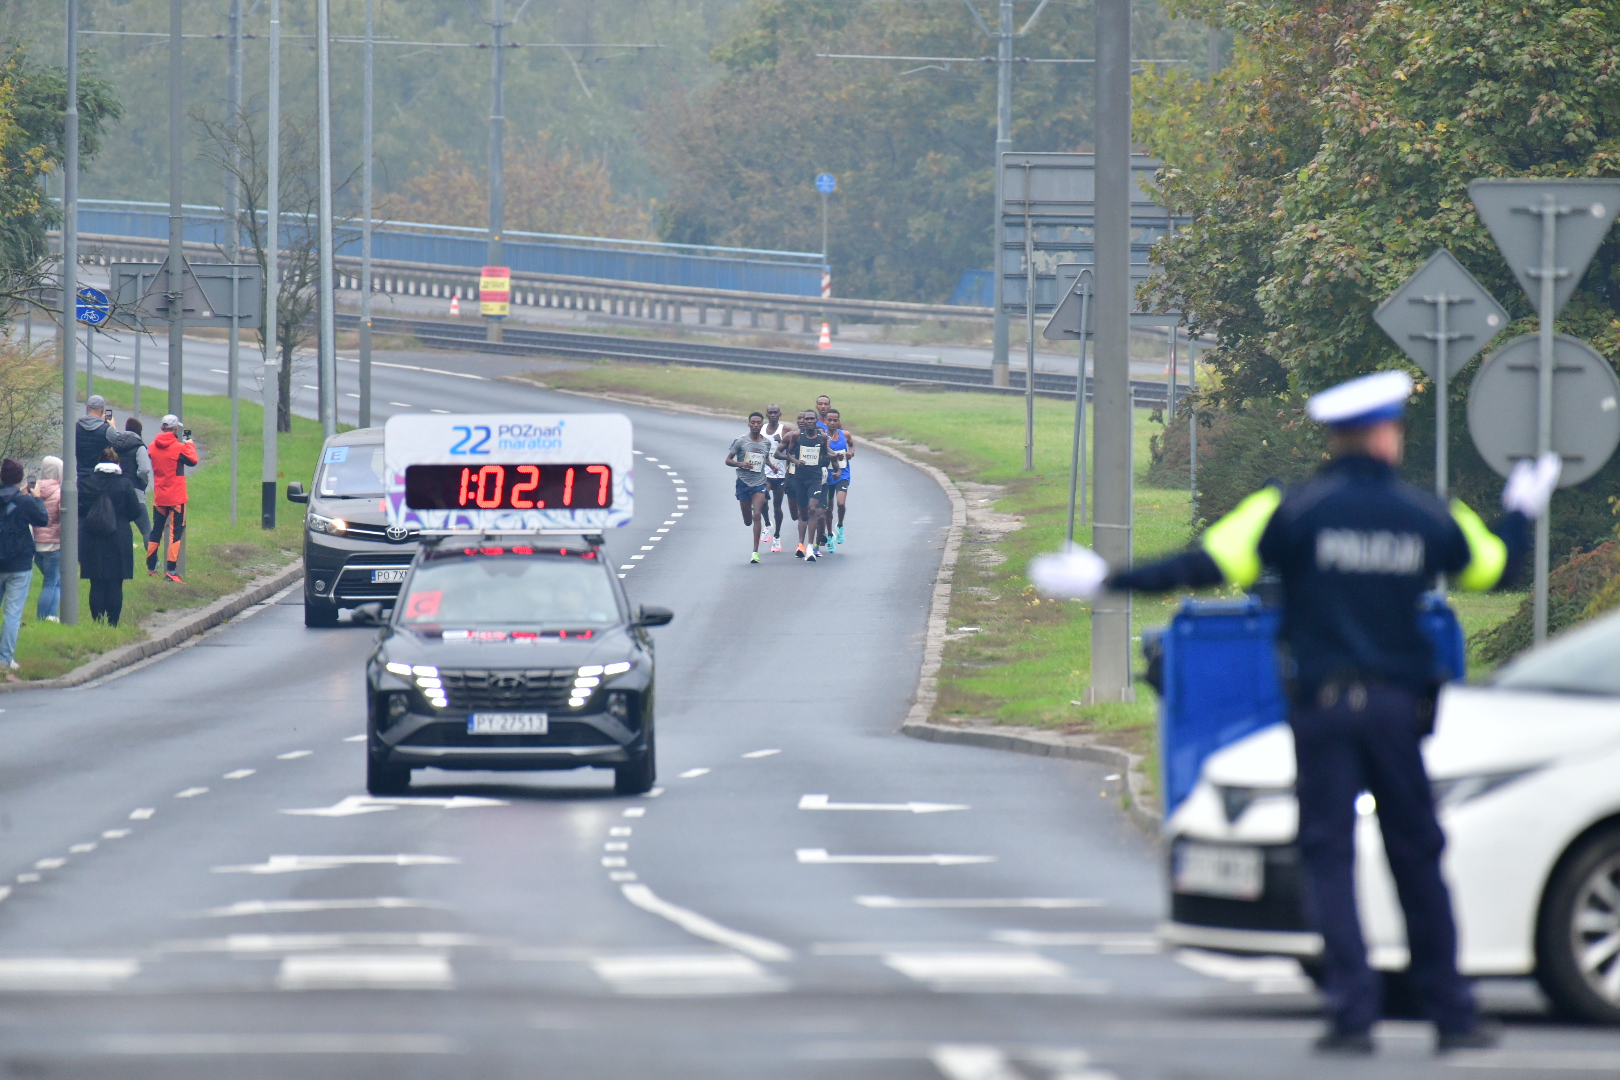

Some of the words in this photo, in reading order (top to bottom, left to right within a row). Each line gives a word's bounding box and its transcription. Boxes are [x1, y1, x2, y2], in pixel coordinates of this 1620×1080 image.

[449, 425, 492, 455] 22
[499, 438, 562, 450] maraton
[330, 450, 343, 461] E
[414, 596, 434, 613] C
